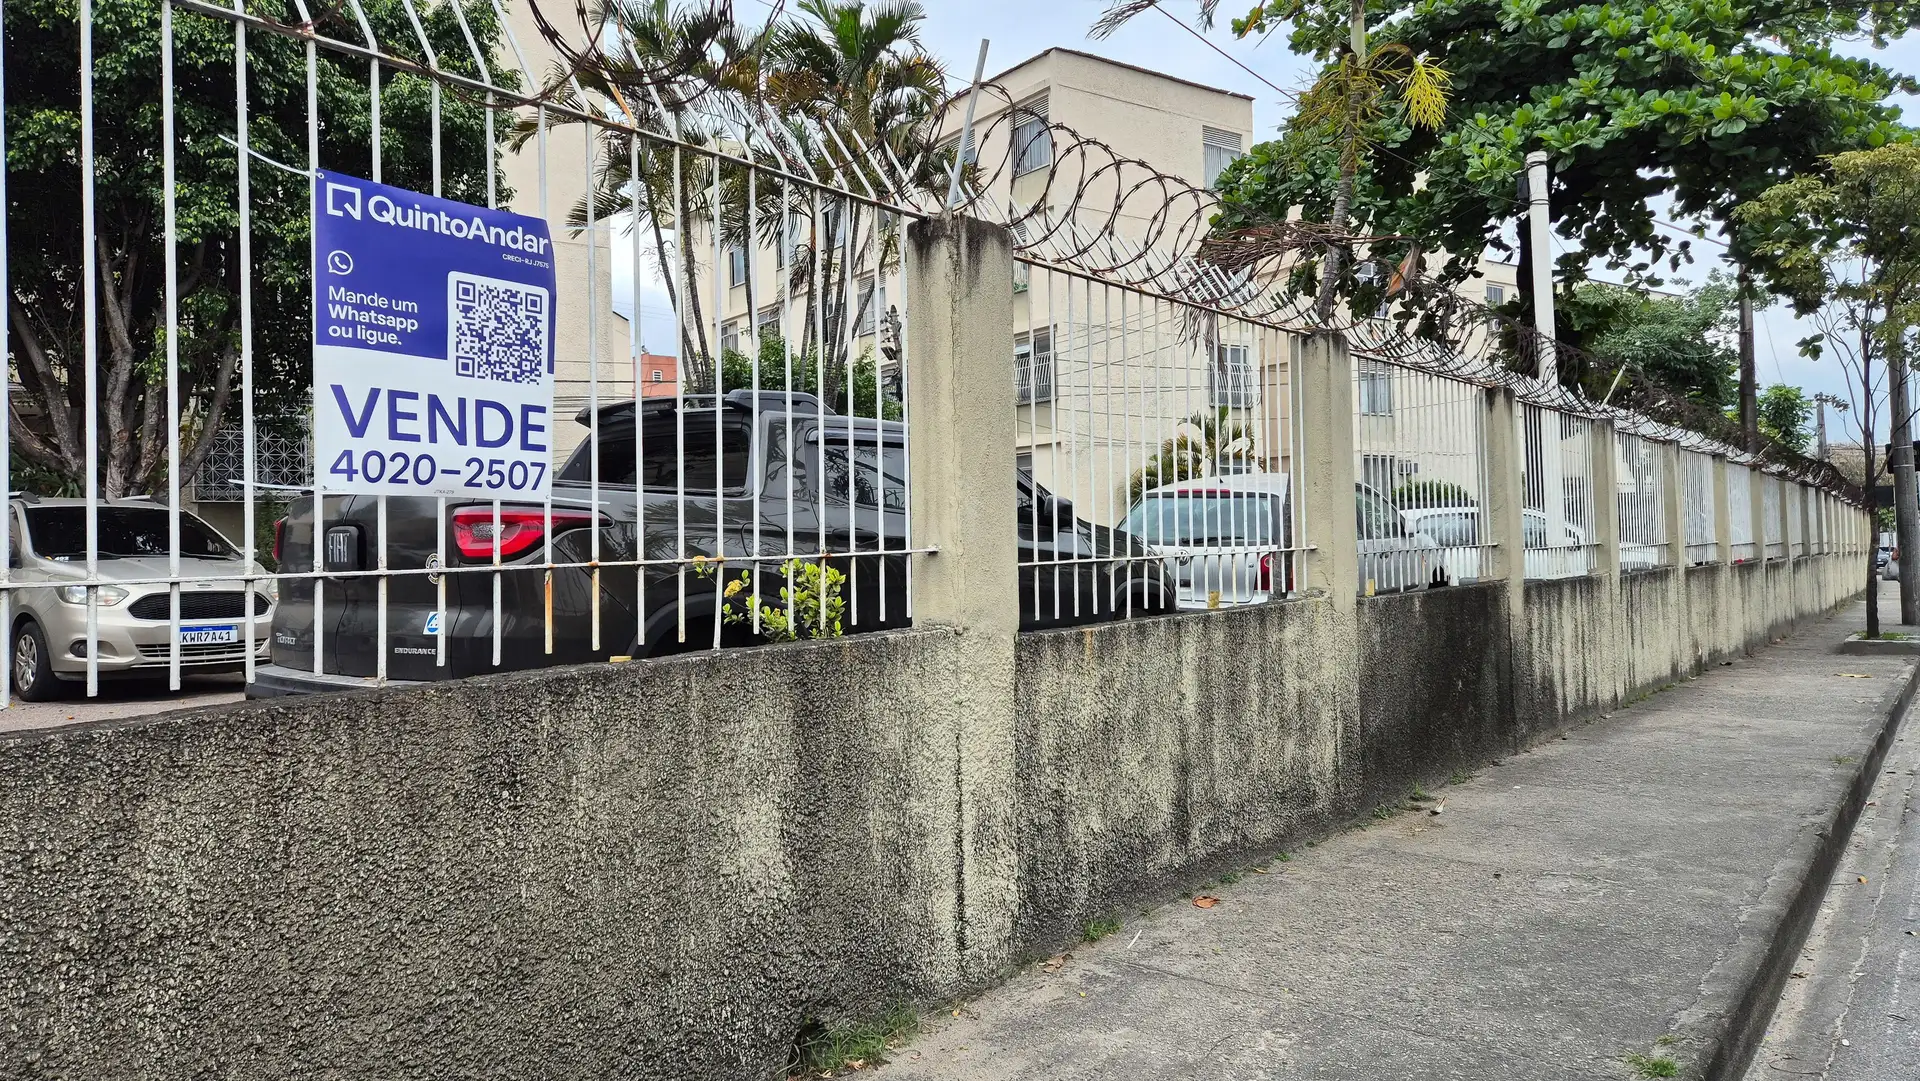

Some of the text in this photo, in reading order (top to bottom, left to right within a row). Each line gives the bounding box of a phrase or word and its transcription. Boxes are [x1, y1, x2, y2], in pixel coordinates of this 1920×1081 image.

[367, 195, 549, 254] QuintoAndar
[502, 253, 533, 266] CRECI-RJ
[328, 285, 418, 313] Mande um
[328, 303, 419, 333] Whatsapp
[328, 325, 402, 345] ou ligue.
[329, 384, 547, 452] VENDE
[329, 449, 547, 491] 4020-2507
[328, 533, 350, 563] FIAT
[182, 631, 231, 643] KWR7A41
[394, 647, 437, 655] ENDURANCE
